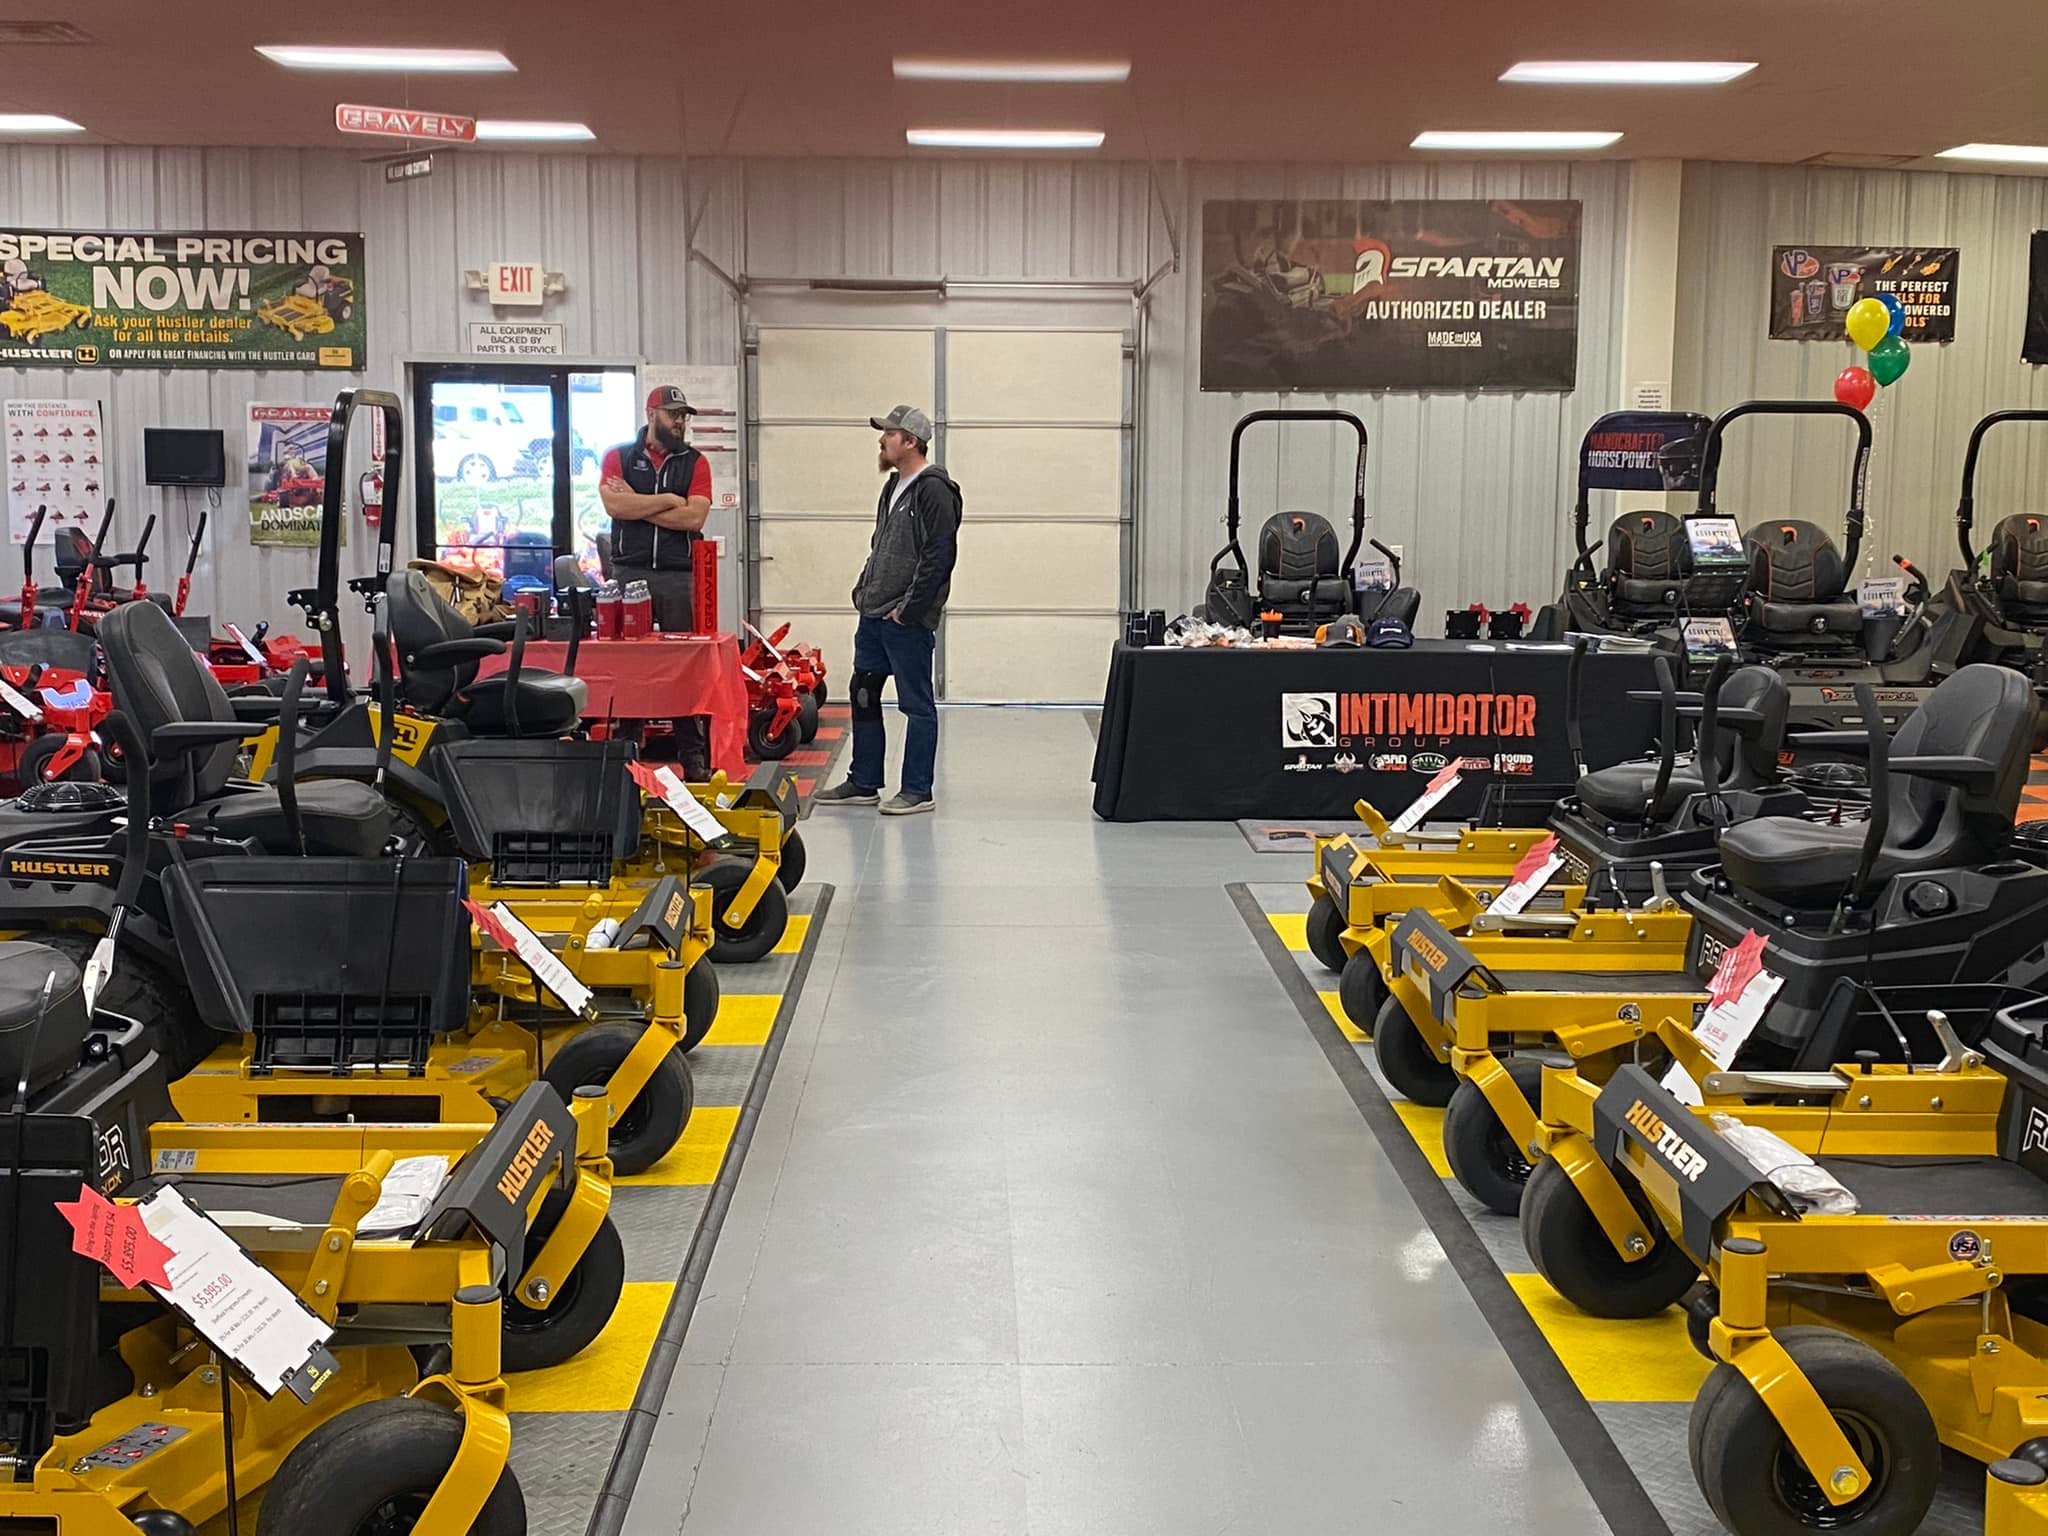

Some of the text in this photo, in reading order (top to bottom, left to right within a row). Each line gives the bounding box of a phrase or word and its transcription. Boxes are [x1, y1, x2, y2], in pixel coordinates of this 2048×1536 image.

[343, 109, 466, 136] GRAVELY
[0, 234, 348, 265] SPECIAL PRICING
[1389, 257, 1564, 277] SPARTAN
[1783, 250, 1808, 276] VP
[500, 267, 533, 292] EXIT
[1488, 279, 1560, 288] MOWERS
[92, 266, 250, 311] NOW!
[1875, 281, 1949, 293] THE PERFECT
[1896, 293, 1940, 304] ELS FOR
[1366, 300, 1546, 320] AUTHORIZED DEALER
[1905, 305, 1950, 316] OWERED
[94, 315, 252, 329] Ask your Hustler dealer
[1905, 317, 1926, 327] OLS
[113, 330, 233, 343] for all the details.
[500, 327, 552, 335] EQUIPMENT
[1428, 331, 1455, 344] MADE
[1463, 331, 1481, 344] USA
[491, 336, 527, 344] BACKED
[109, 349, 122, 359] OR
[124, 349, 145, 359] APPLY
[147, 350, 161, 359] FOR
[163, 350, 185, 359] GREAT
[187, 350, 226, 360] FINANCING
[228, 351, 246, 360] WITH
[248, 351, 262, 360] THE
[264, 351, 295, 361] HUSTLER
[297, 352, 316, 361] CARD
[477, 345, 506, 353] PARTS
[519, 346, 557, 354] SERVICE
[250, 502, 347, 524] LANDSCAE
[261, 520, 320, 531] DOMINAT
[705, 549, 713, 630] GRAVELY
[1340, 693, 1537, 737] INTIMIDATOR
[1339, 737, 1450, 748] GROUP
[11, 861, 110, 876] HUSTLER
[1406, 928, 1448, 972] HUSTLER
[1624, 1099, 1707, 1182] HUSTLER
[497, 1119, 554, 1205] HUSTLER
[1951, 1241, 1980, 1252] USA
[192, 1273, 232, 1309] $5,995.00
